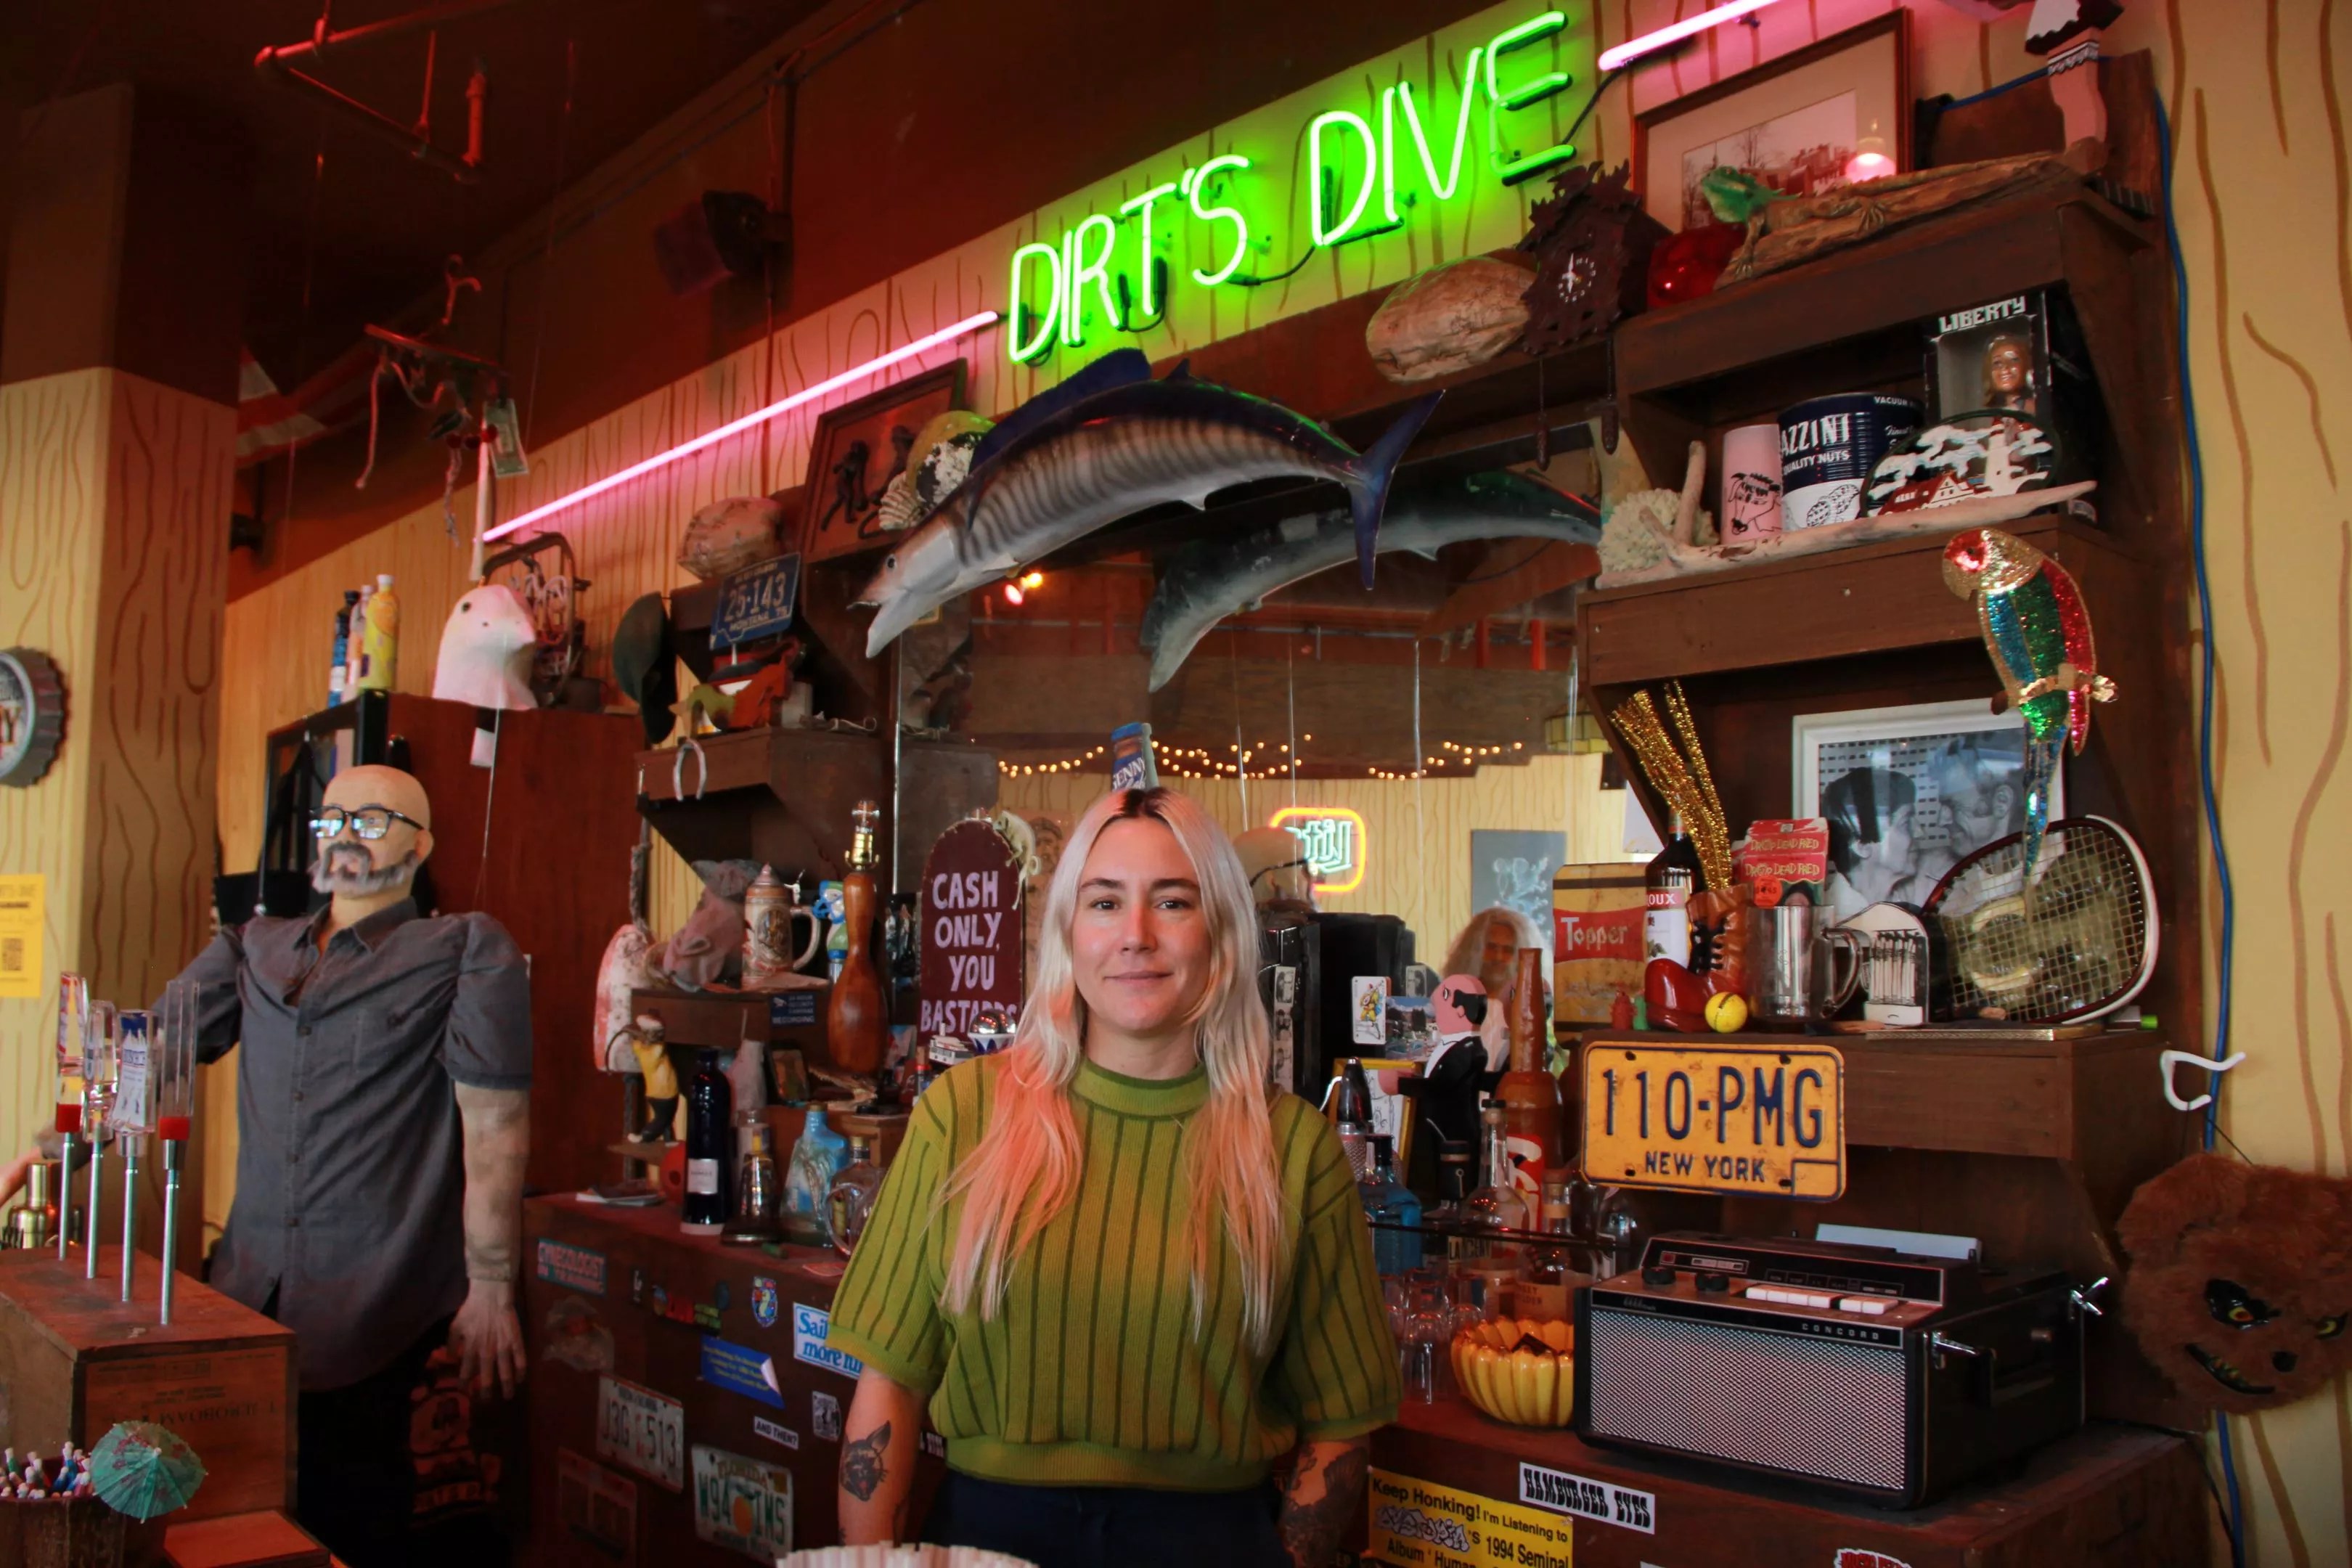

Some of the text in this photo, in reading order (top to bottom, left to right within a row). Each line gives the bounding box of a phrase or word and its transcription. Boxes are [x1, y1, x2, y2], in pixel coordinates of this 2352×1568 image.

[1008, 10, 1577, 363] DIRT'S DIVE
[1938, 295, 2026, 334] LIBERTY
[1873, 396, 1908, 406] VACUUM
[1818, 449, 1850, 464] NUTS
[1800, 838, 1820, 849] FRED
[1774, 862, 1797, 875] DEAD
[1797, 862, 1821, 875] FRED
[932, 870, 999, 910] CASH
[934, 911, 1003, 952] ONLY,
[1560, 916, 1628, 952] Topper
[948, 955, 995, 992] YOU
[1602, 1065, 1824, 1148] 110-PMG
[1644, 1151, 1766, 1183] NEW YORK
[1801, 1322, 1881, 1341] CONCORD
[802, 1341, 842, 1367] more
[756, 1421, 798, 1446] AND THEN?
[1373, 1477, 1569, 1543] Keep Honking! I'm Listening to
[1524, 1467, 1651, 1529] HAMBURGER EYES
[1387, 1538, 1425, 1564] Album
[1486, 1535, 1514, 1562] 1994
[1516, 1543, 1569, 1568] Seminal
